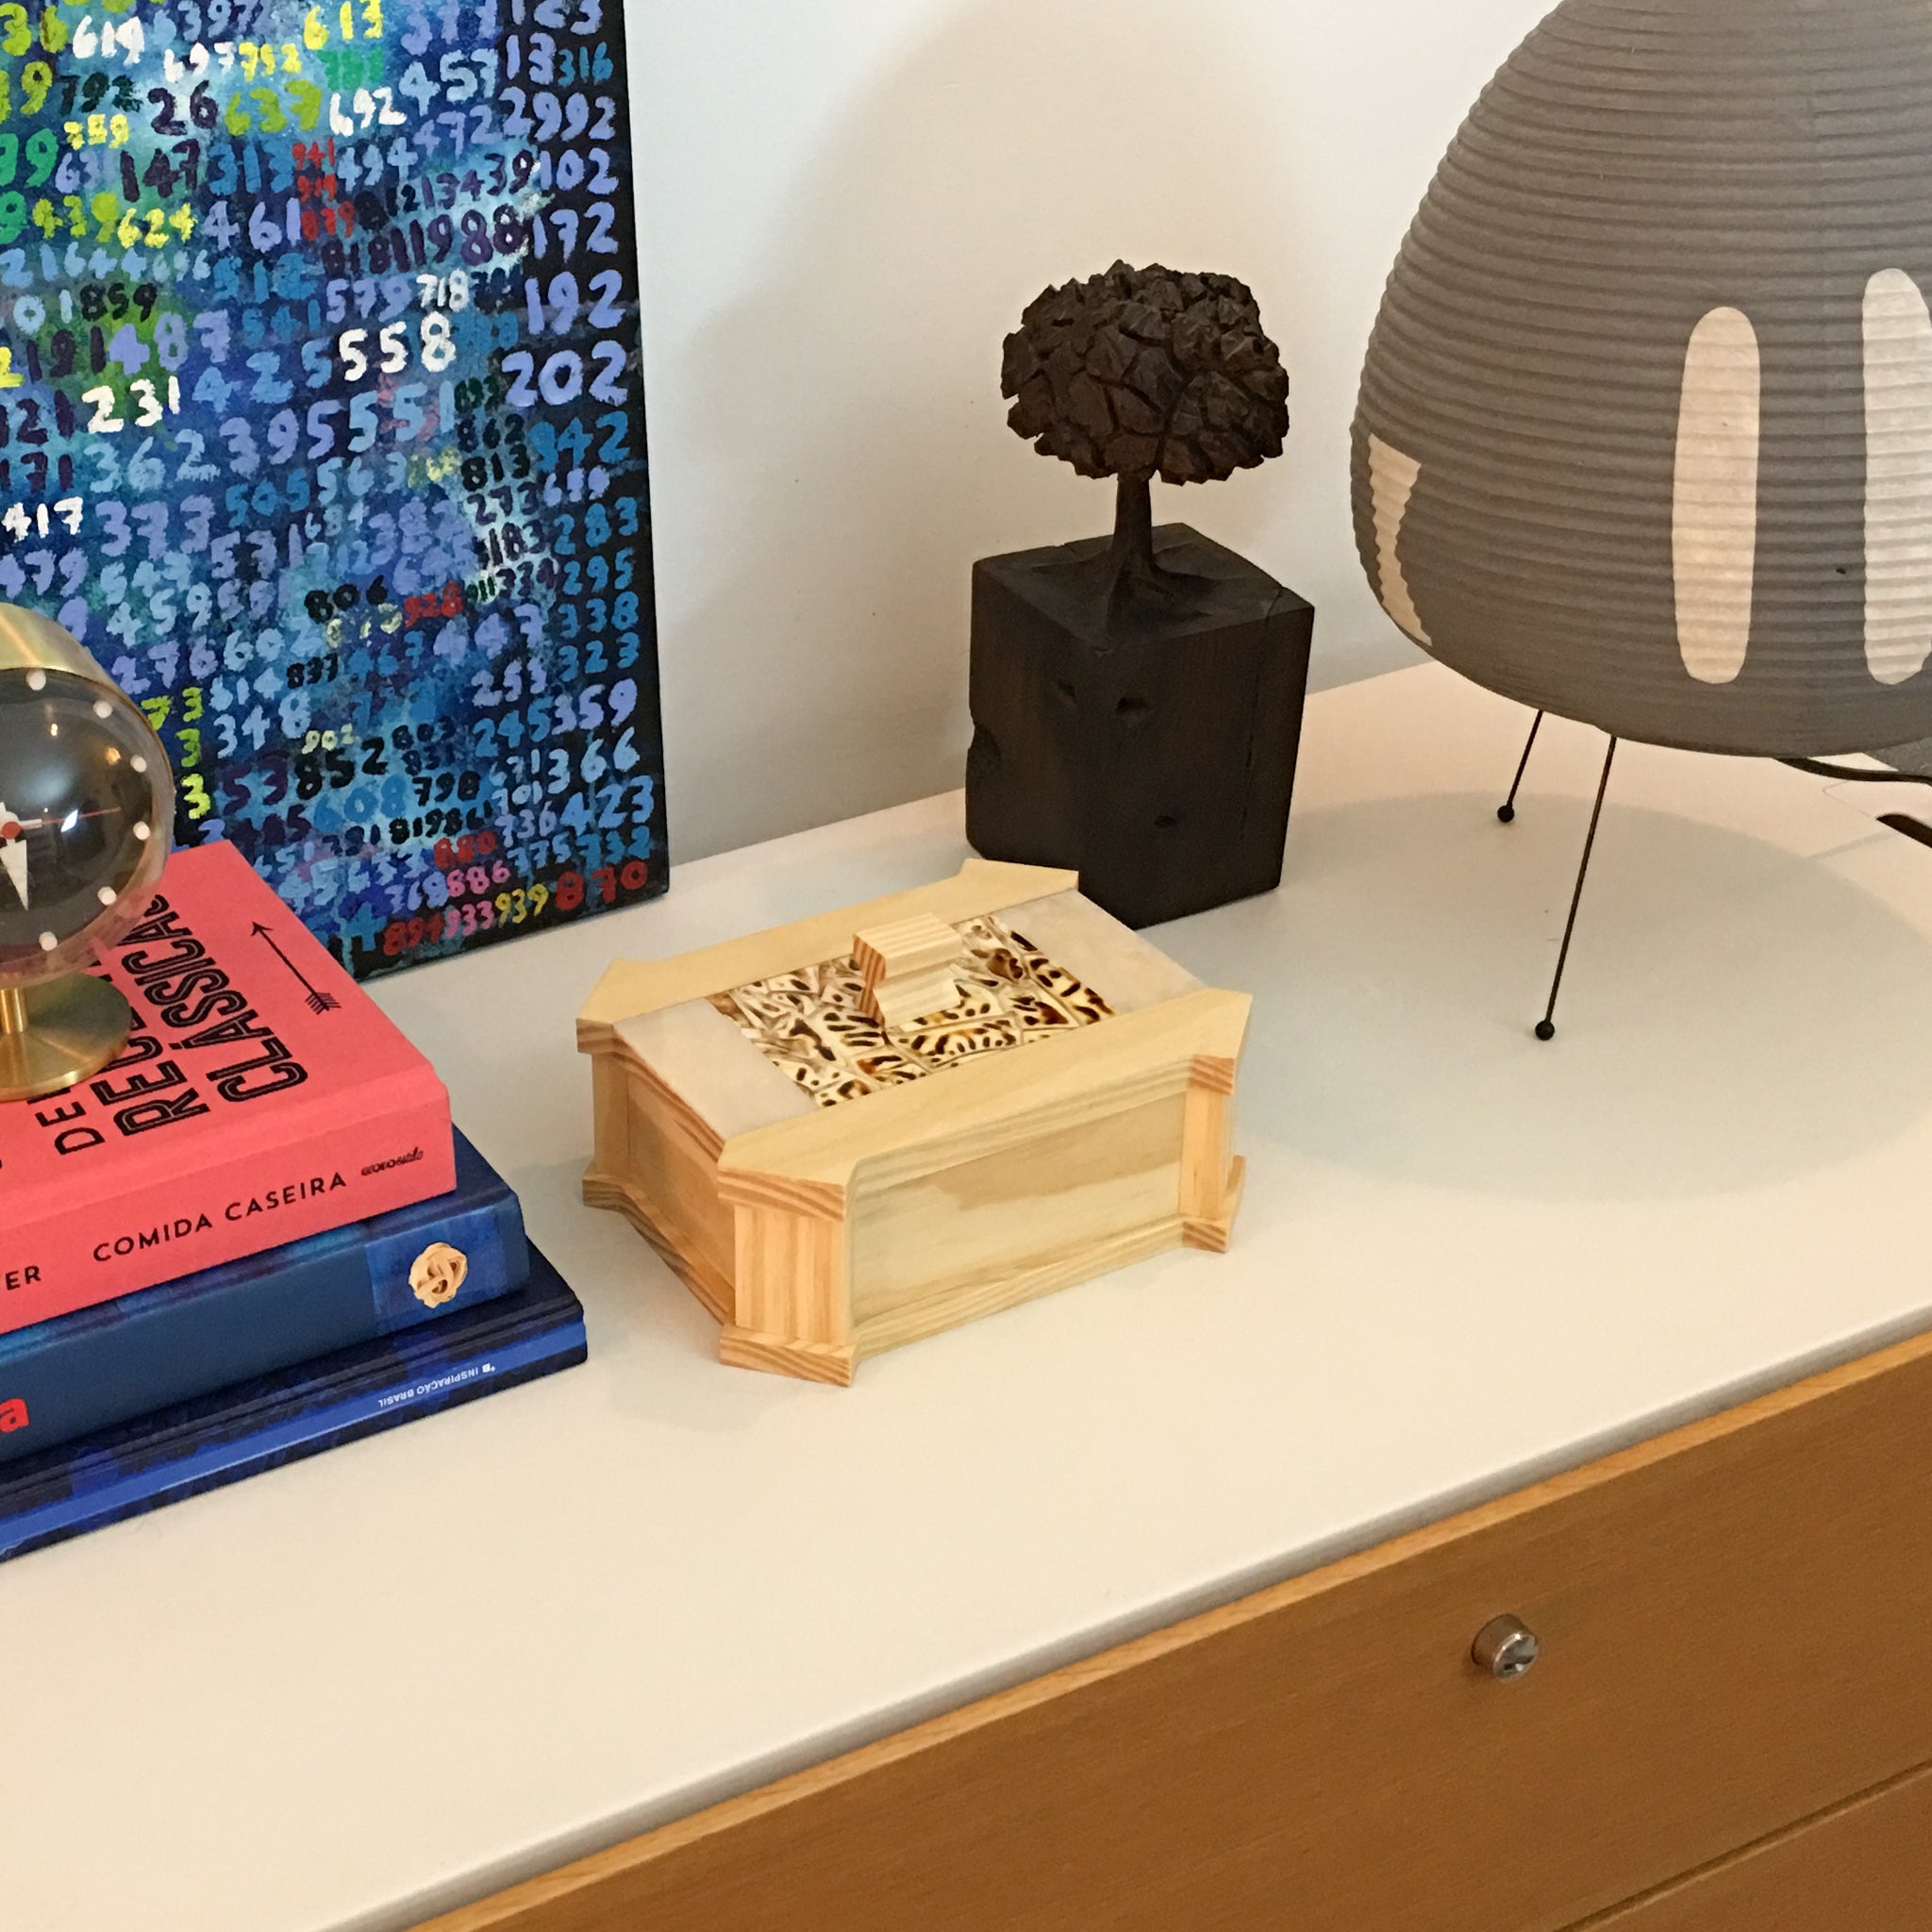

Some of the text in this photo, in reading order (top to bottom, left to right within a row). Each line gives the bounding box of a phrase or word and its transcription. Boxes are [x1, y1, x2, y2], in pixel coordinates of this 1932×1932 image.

[73, 15, 144, 68] 619
[147, 79, 219, 136] 26
[330, 86, 407, 137] 692
[120, 139, 201, 203] 147
[540, 149, 619, 194] 102
[532, 202, 618, 263] 172
[79, 283, 158, 323] 859
[416, 269, 470, 312] 718
[525, 272, 625, 335] 192
[339, 311, 457, 381] 558
[501, 341, 628, 408] 202
[81, 375, 180, 434] 231
[1, 496, 83, 543] 417
[555, 497, 639, 555] 283
[562, 547, 633, 595] 295
[304, 575, 388, 625] 806
[495, 883, 549, 928] 939
[556, 860, 648, 911] 870
[92, 1212, 213, 1262] COMIDA
[225, 1171, 347, 1223] CASEIRA
[378, 1390, 414, 1407] BRASIL
[416, 1367, 479, 1395] INSPIRAÇÃO
